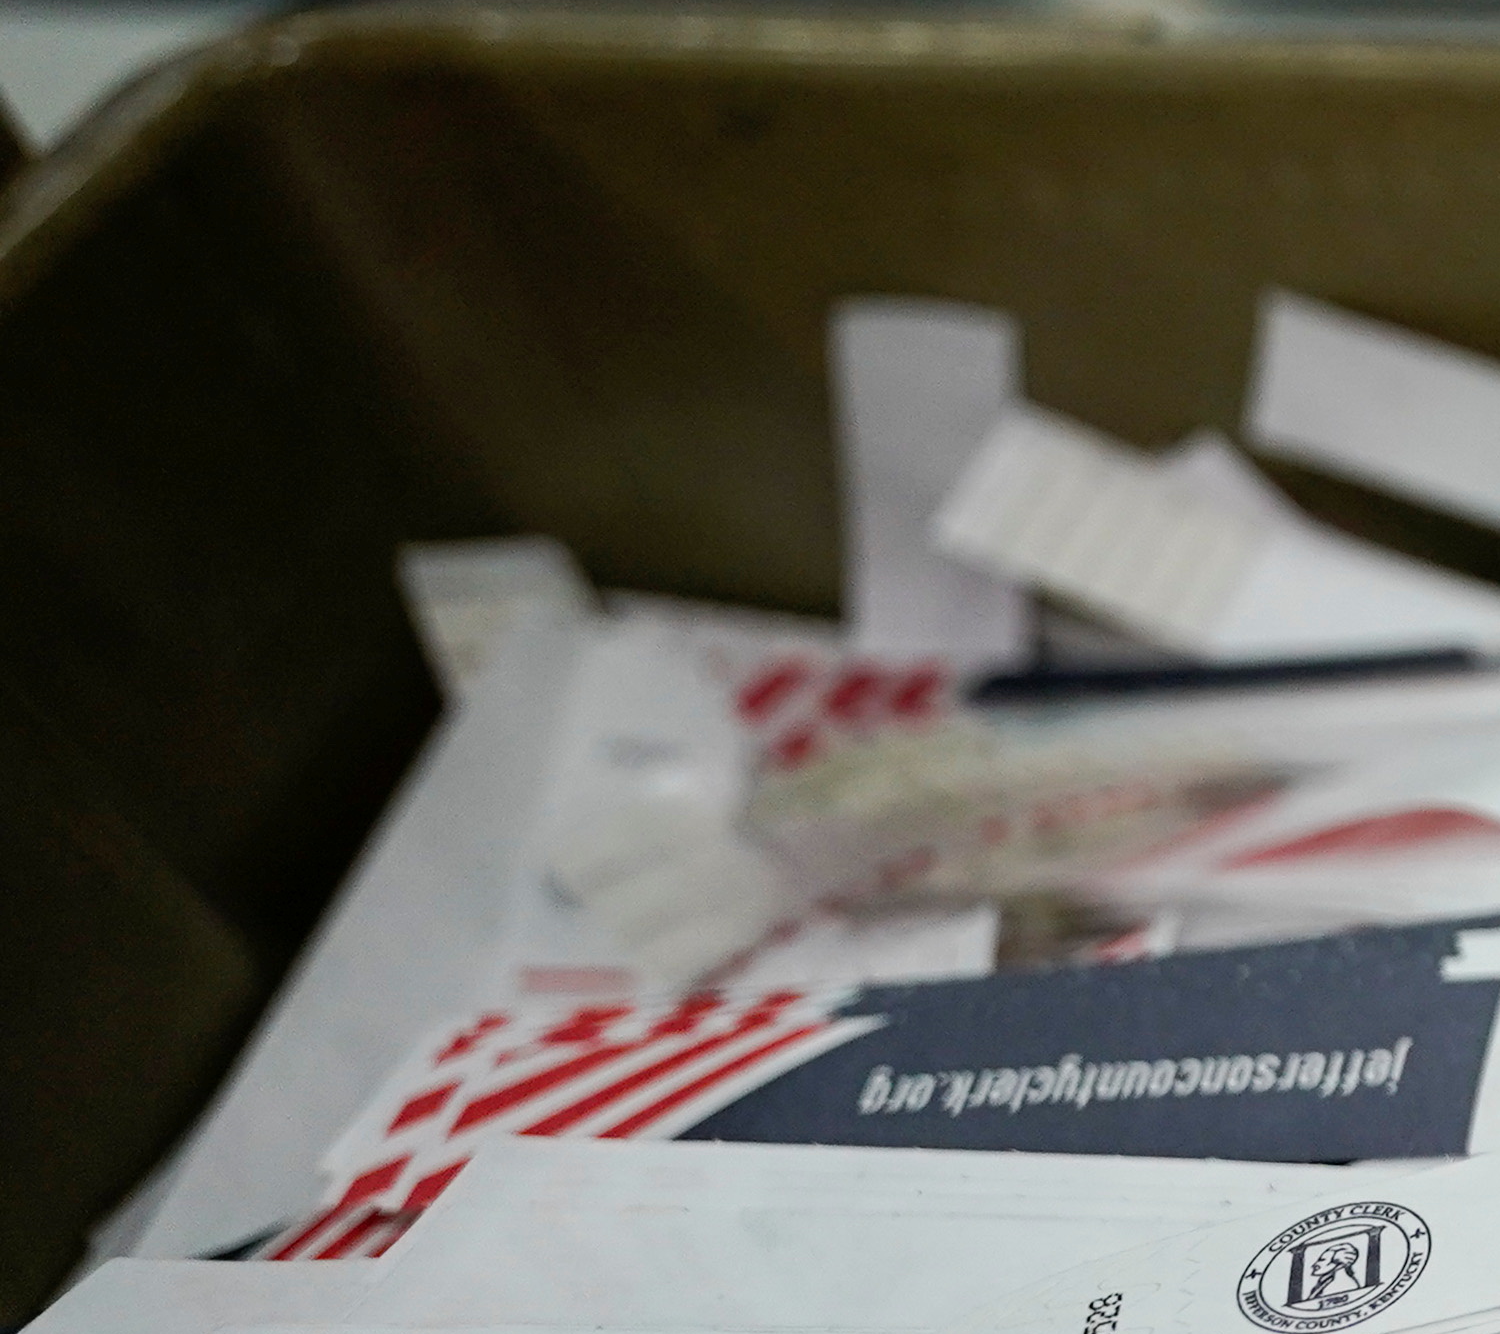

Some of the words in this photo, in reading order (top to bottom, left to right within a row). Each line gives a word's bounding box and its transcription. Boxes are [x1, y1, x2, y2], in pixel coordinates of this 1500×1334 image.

[861, 1033, 1413, 1117] jeffersoncountyclerk.org
[1269, 1207, 1344, 1253] COUNTY
[1349, 1205, 1408, 1222] CLERK
[1294, 1311, 1368, 1331] COUNTY,
[1368, 1251, 1424, 1310] KENTUCKY
